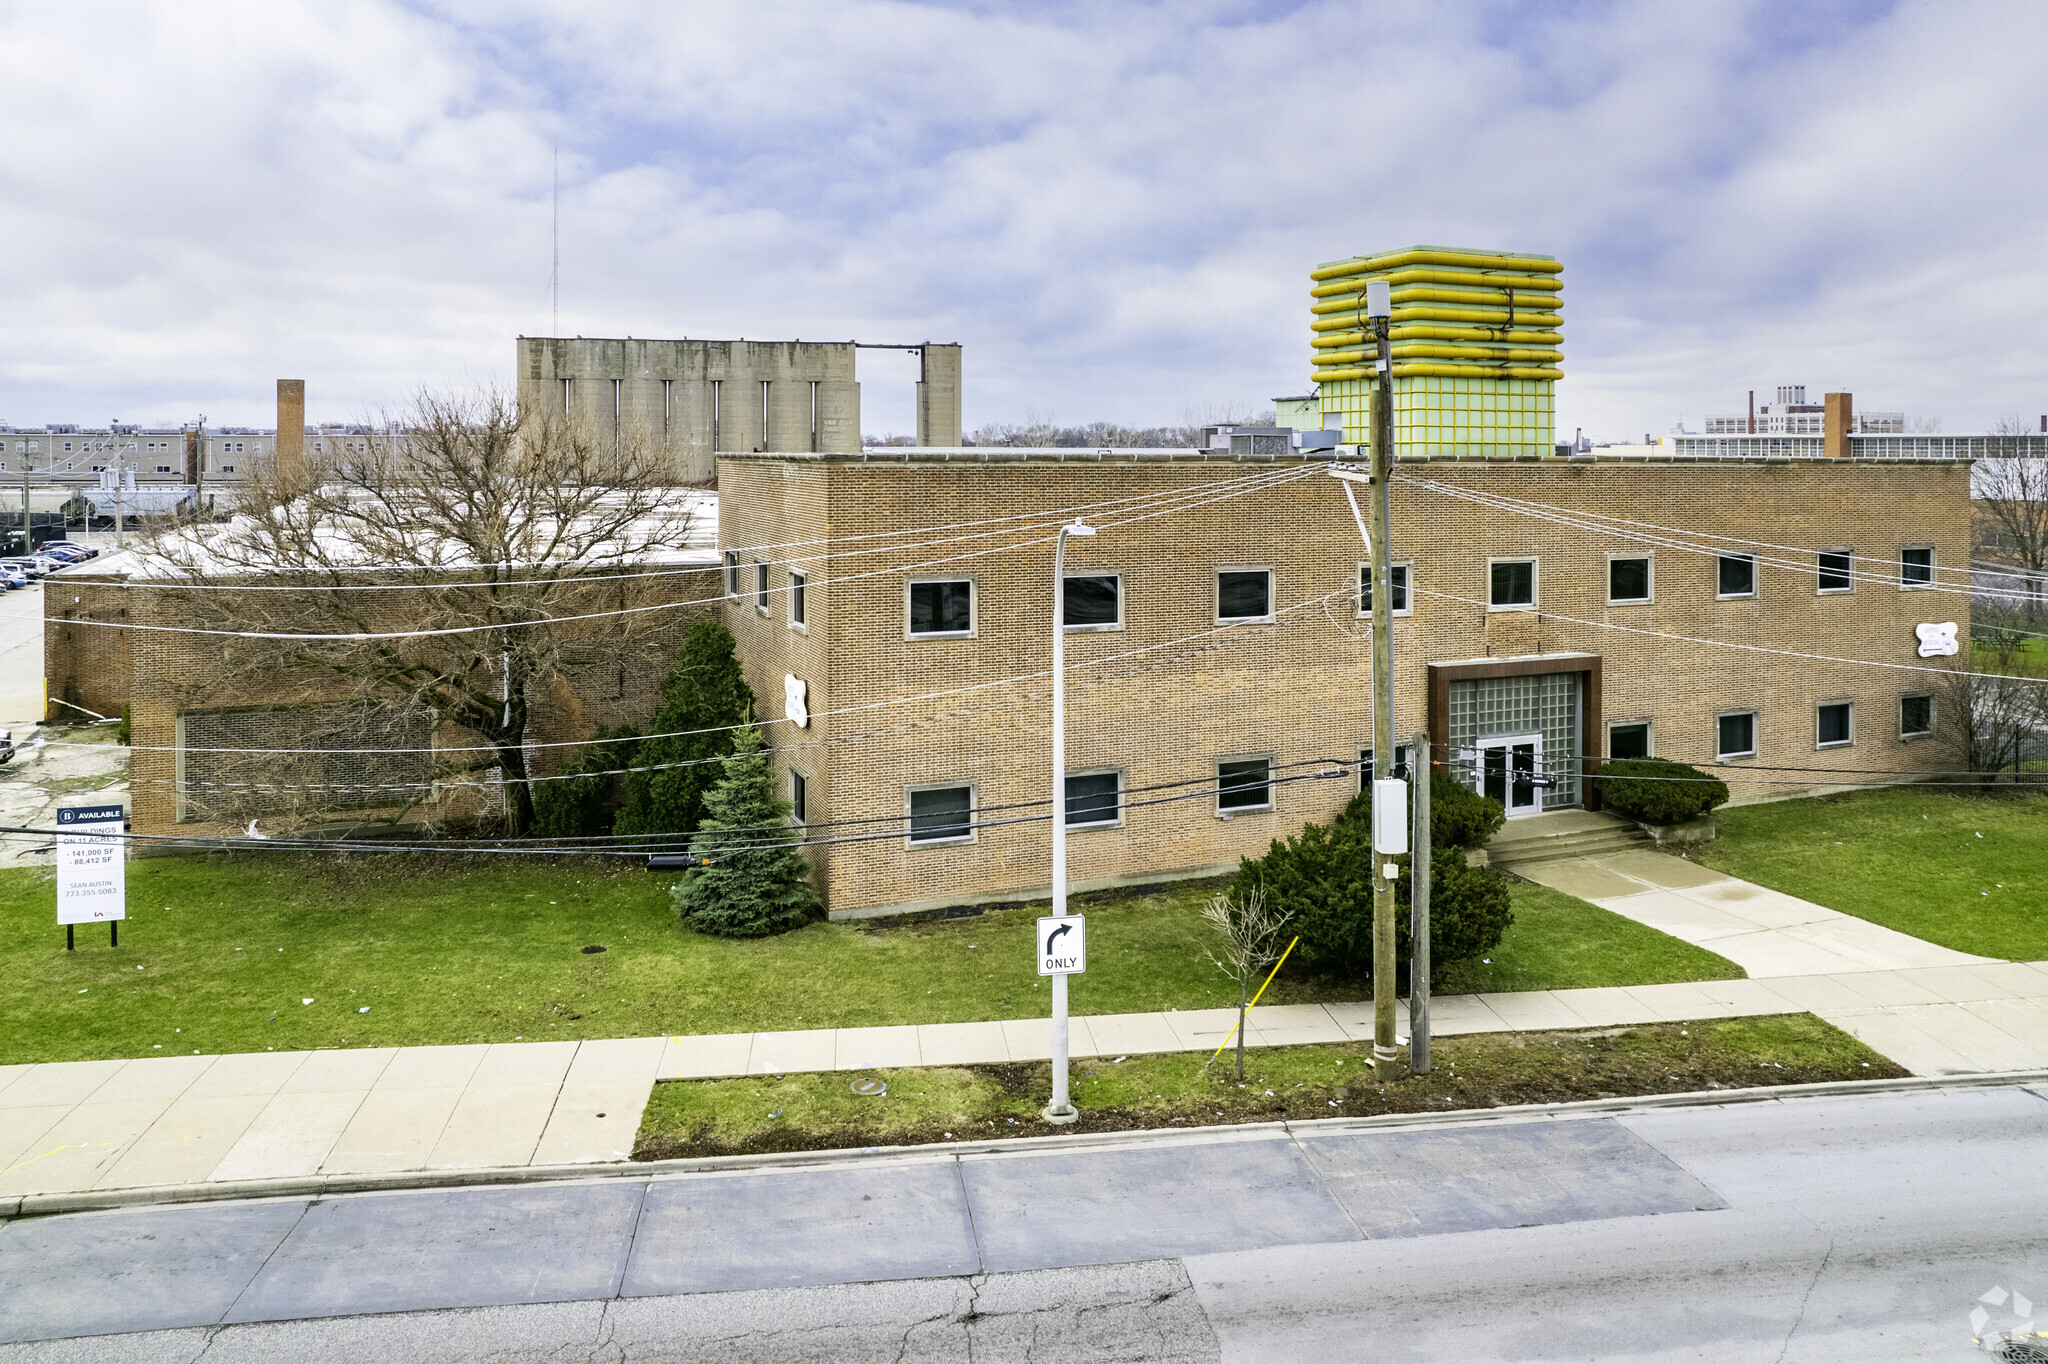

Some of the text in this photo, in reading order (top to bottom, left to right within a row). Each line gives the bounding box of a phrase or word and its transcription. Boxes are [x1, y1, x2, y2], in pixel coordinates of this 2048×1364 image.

[78, 810, 120, 819] AVAILABLE
[89, 880, 112, 888] AUSTIN
[1046, 957, 1077, 969] ONLY
